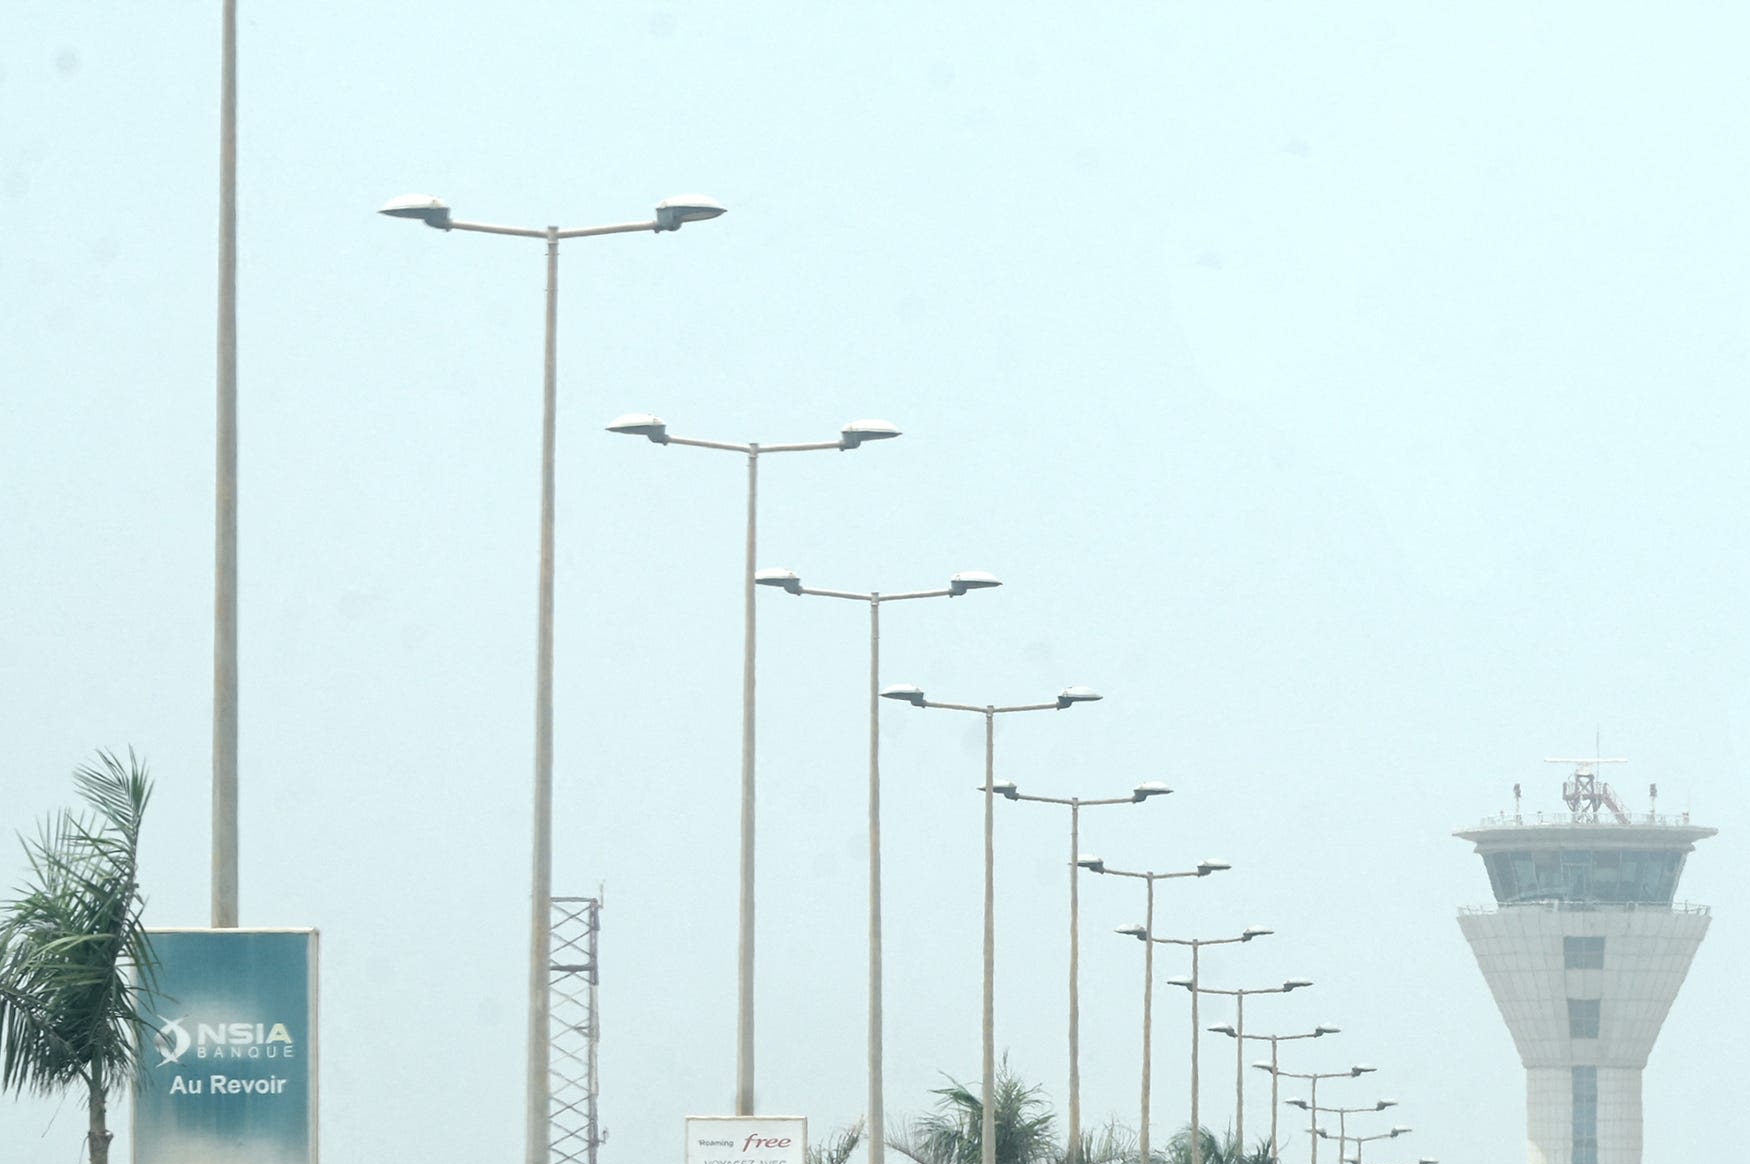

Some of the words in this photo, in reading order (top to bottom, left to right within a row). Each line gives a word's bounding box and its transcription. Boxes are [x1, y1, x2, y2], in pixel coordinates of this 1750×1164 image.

[197, 1022, 293, 1045] NSIA
[197, 1045, 295, 1059] BANQUE
[169, 1075, 202, 1094] Au
[210, 1075, 287, 1094] Revoir
[698, 1139, 734, 1148] Roaming
[742, 1133, 791, 1152] free
